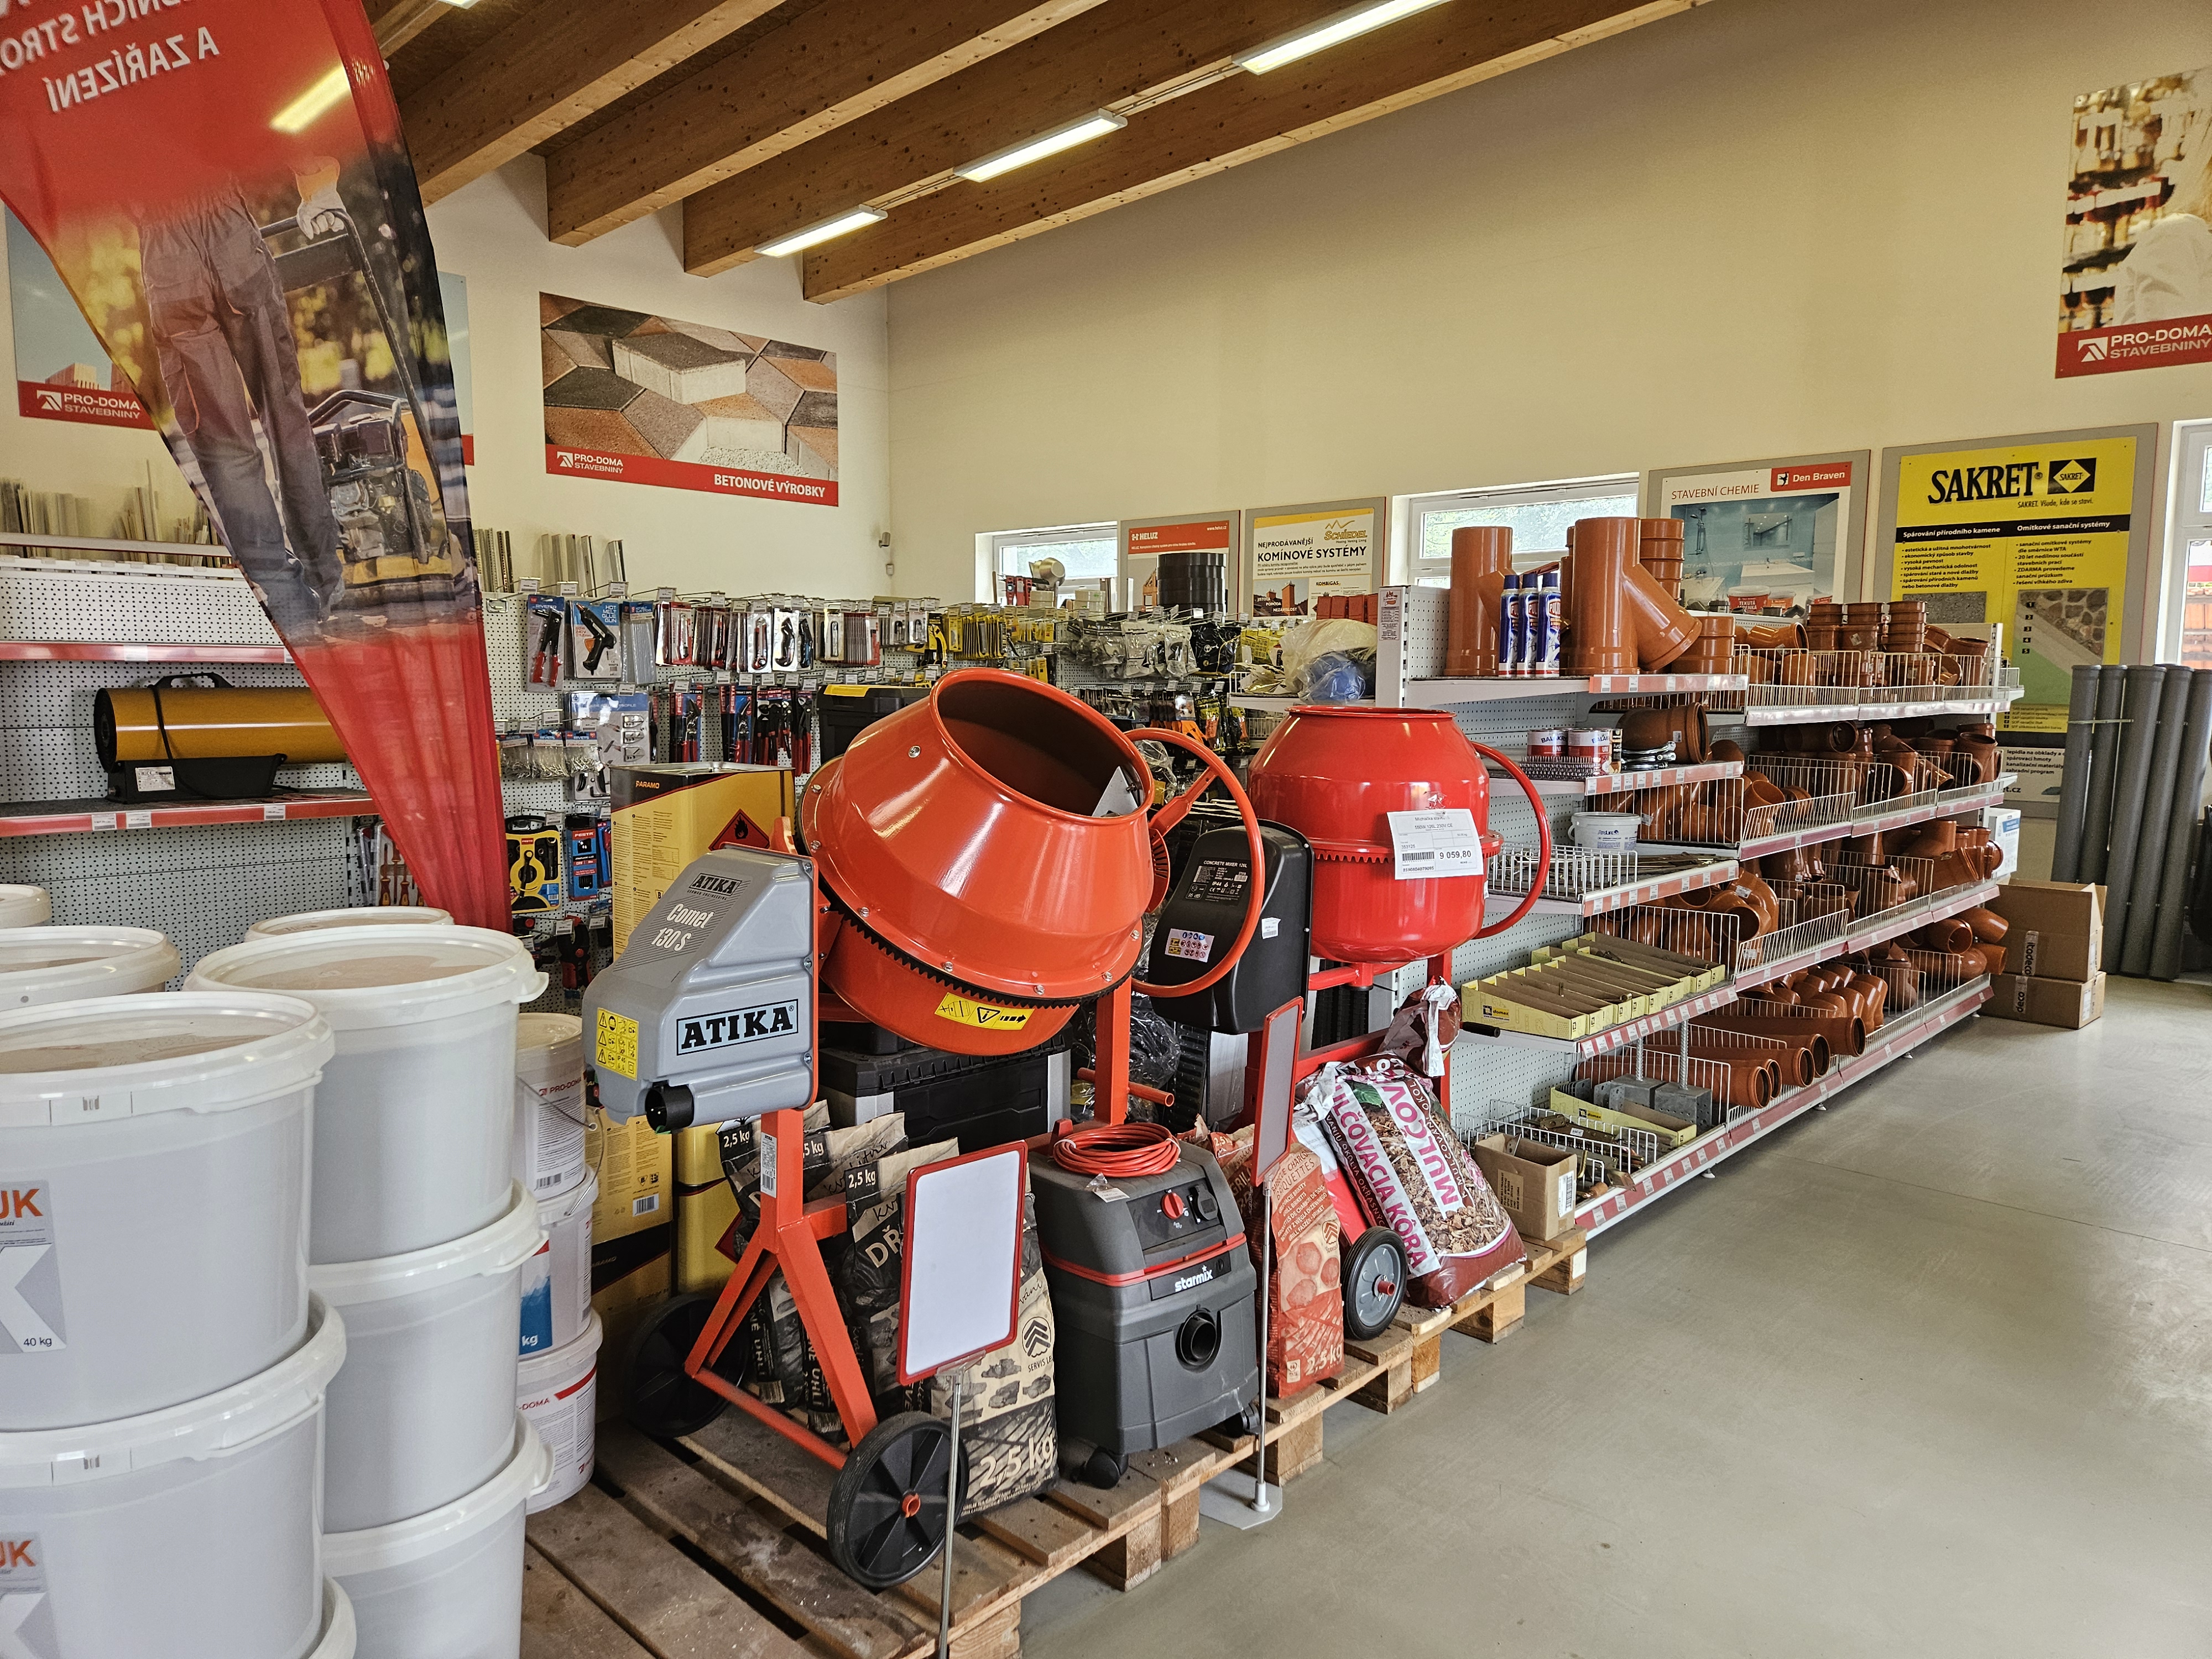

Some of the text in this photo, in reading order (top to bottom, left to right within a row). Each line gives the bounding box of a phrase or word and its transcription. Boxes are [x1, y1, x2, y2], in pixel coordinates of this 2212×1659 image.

[2111, 324, 2212, 347] PRO-DOMA
[2110, 338, 2211, 359] STAVEBNINY
[64, 393, 140, 410] PRO-DOMA
[65, 404, 140, 419] STAVEBNINY
[575, 453, 623, 467] PRO-DOMA
[575, 462, 623, 474] STAVEBNINY
[1793, 471, 1845, 482] Den Braven
[1928, 462, 2039, 504] SAKRET
[714, 474, 825, 498] BETONOVÉ VÝROBKY
[1672, 484, 1760, 500] STAVEBNÍ CHEMIE
[1937, 528, 1972, 536] přírodního
[1258, 538, 1313, 549] NEJPRODÁVANĚJŠÍ
[1258, 545, 1366, 562] KOMÍNOVÉ SYSTÉMY
[635, 780, 660, 789] PARAMO
[1446, 851, 1472, 859] 059,80
[692, 875, 737, 894] ATIKA
[666, 903, 715, 929] Comet
[651, 927, 692, 951] 130 S
[681, 1006, 793, 1050] ATIKA
[550, 1077, 581, 1094] PRO-DOMA
[723, 1130, 750, 1148] 2,5 kg
[1214, 1136, 1225, 1146] 2,5
[811, 1141, 824, 1156] kg
[1342, 1143, 1359, 1176] OKOLIA
[848, 1169, 877, 1188] 2,5 kg
[1271, 1168, 1286, 1194] BARBECUE
[1276, 1158, 1315, 1201] BRIQUETTES
[1292, 1181, 1306, 1199] BRIKETY
[1290, 1212, 1297, 1220] DE
[1296, 1197, 1311, 1214] CHARBON
[1295, 1211, 1308, 1225] WĘGLA
[1385, 1202, 1428, 1269] KÔRA
[1175, 1266, 1213, 1291] starmix
[23, 1337, 53, 1347] 40 kg
[521, 1334, 539, 1347] kg
[1028, 1359, 1046, 1373] SERVIS
[1307, 1342, 1342, 1372] 2,5 kg
[979, 1445, 1022, 1488] 2,5
[1029, 1432, 1054, 1469] kg
